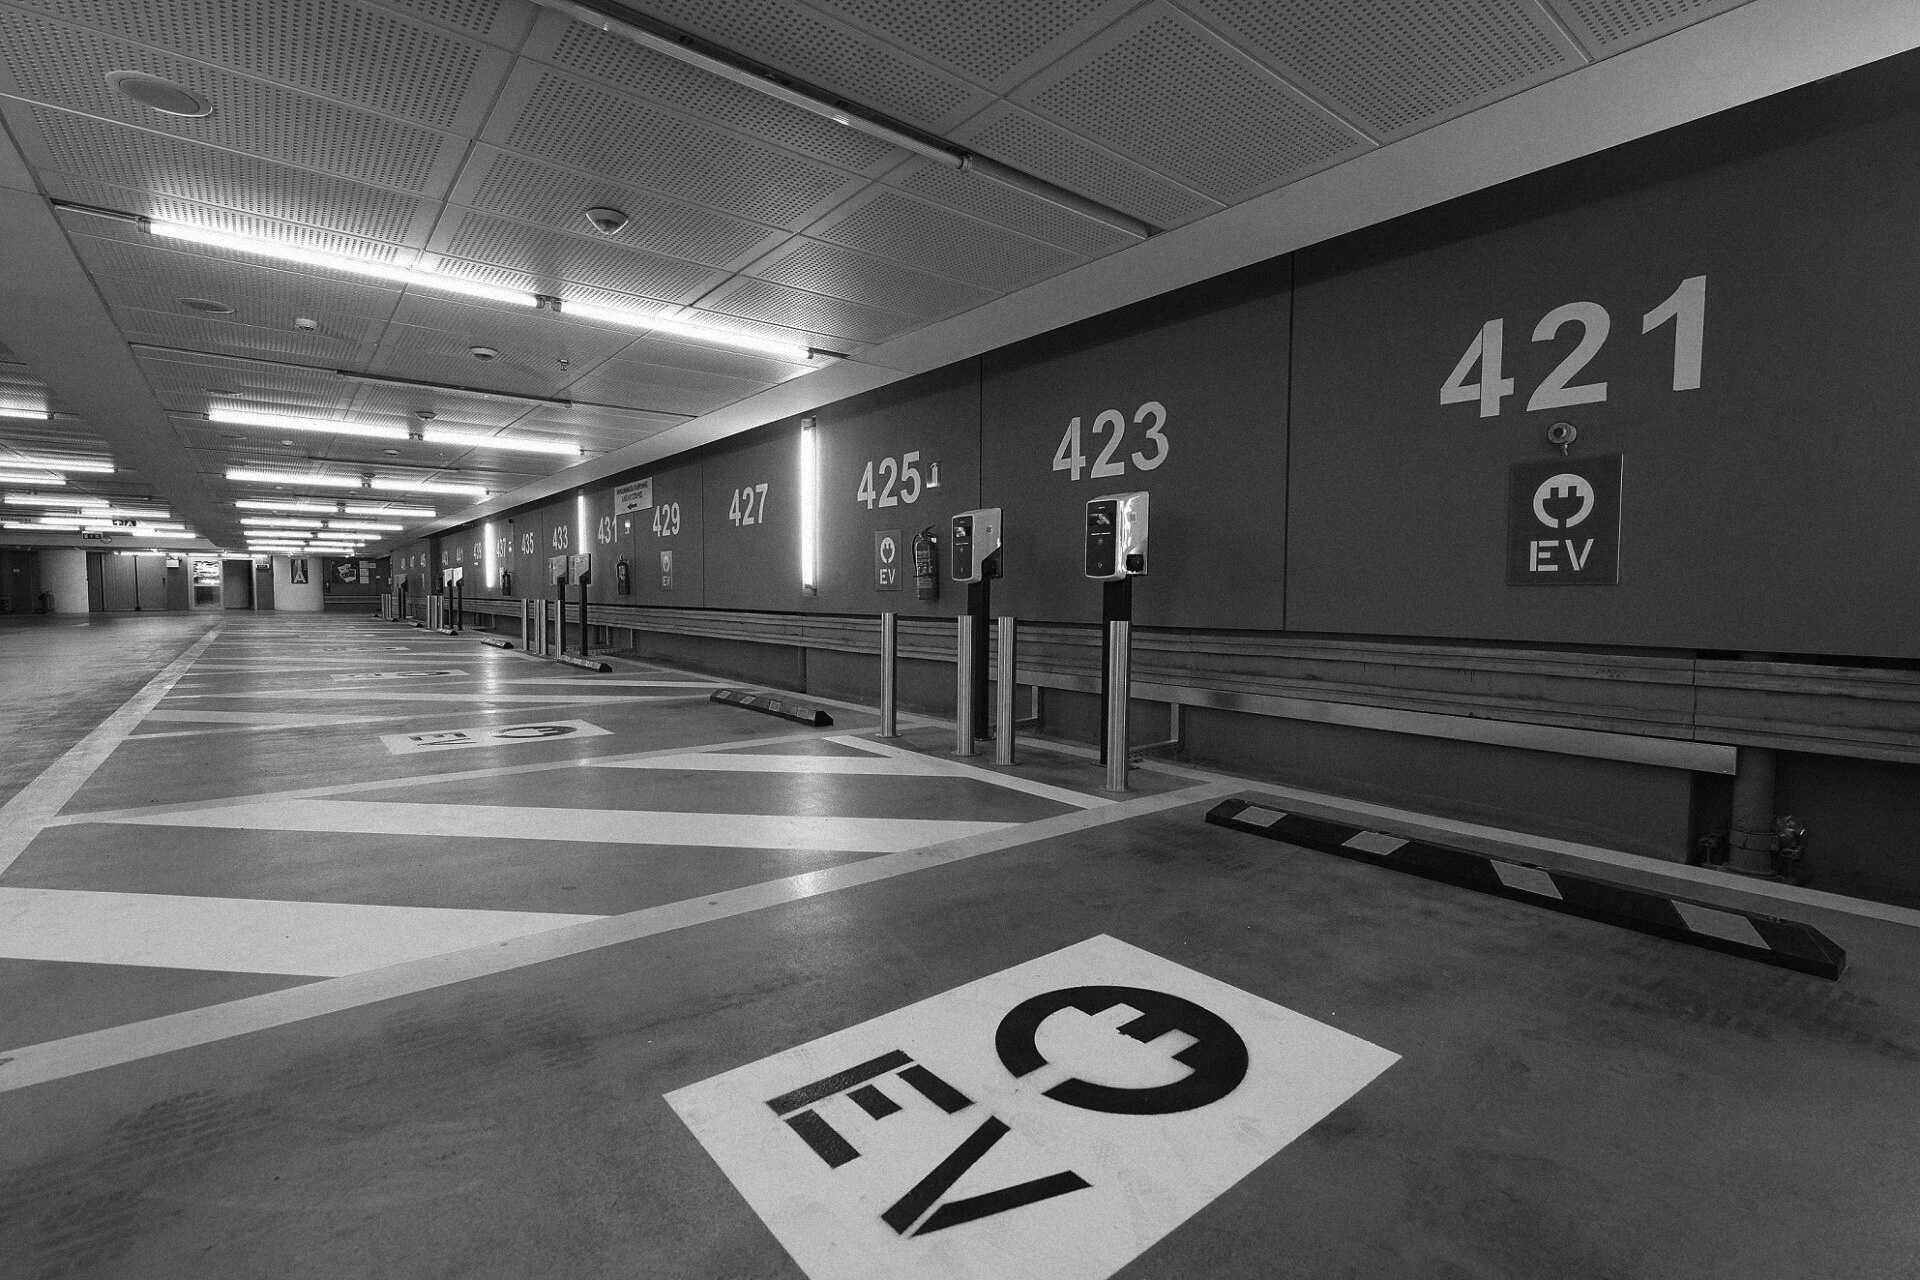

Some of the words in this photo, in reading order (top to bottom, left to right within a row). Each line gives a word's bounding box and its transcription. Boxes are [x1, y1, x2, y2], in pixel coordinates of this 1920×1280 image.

[1440, 275, 1707, 418] 421
[1053, 401, 1169, 481] 423
[857, 450, 921, 510] 425
[652, 502, 681, 537] 429
[729, 483, 769, 527] 427
[521, 532, 534, 555] 435
[552, 524, 569, 551] 433
[598, 515, 618, 544] 431
[496, 538, 507, 558] 437
[1529, 538, 1594, 572] EV
[879, 569, 896, 585] EV
[766, 1048, 1093, 1238] EV
